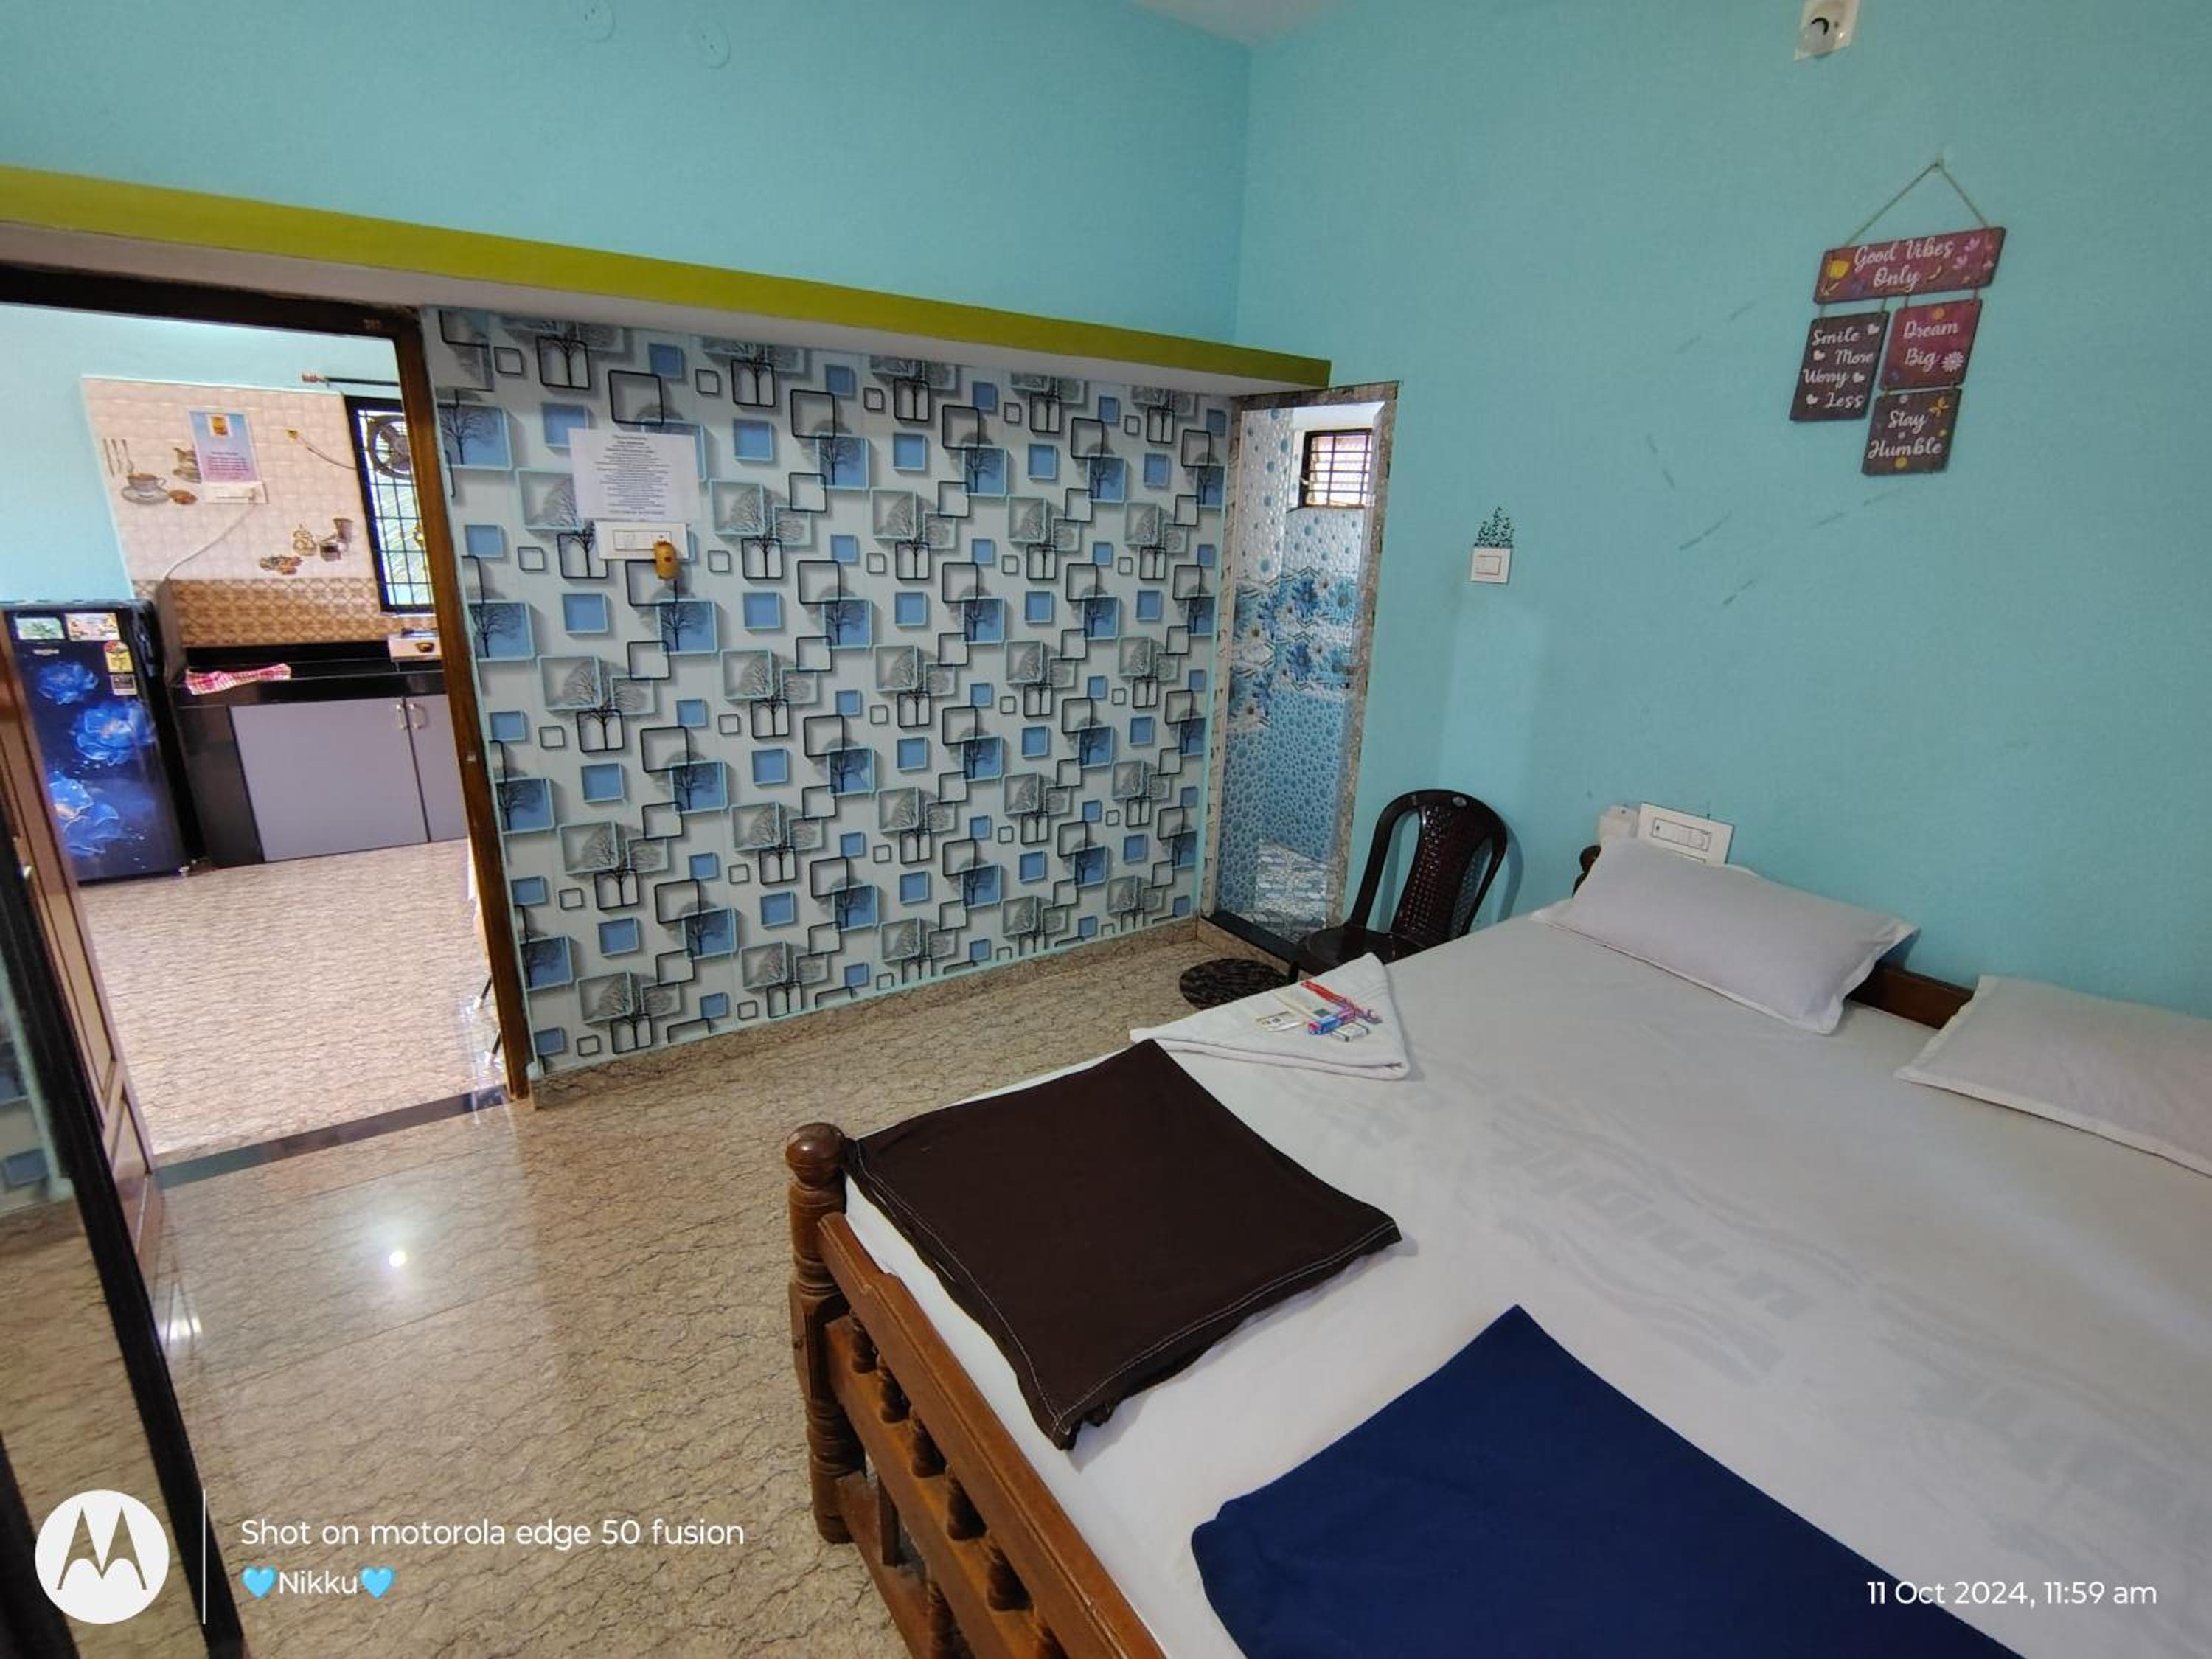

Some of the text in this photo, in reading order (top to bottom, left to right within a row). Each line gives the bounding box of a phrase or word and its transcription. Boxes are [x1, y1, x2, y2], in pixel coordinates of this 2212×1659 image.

[1854, 237, 1955, 271] Good Vibes
[1874, 266, 1920, 295] Only
[1812, 326, 1860, 346] Smile
[1903, 320, 1959, 340] Dream
[1834, 349, 1874, 365] More
[1905, 348, 1937, 373] Big
[1823, 392, 1865, 409] Less
[1888, 411, 1927, 433] Stay
[1868, 435, 1943, 459] Humble
